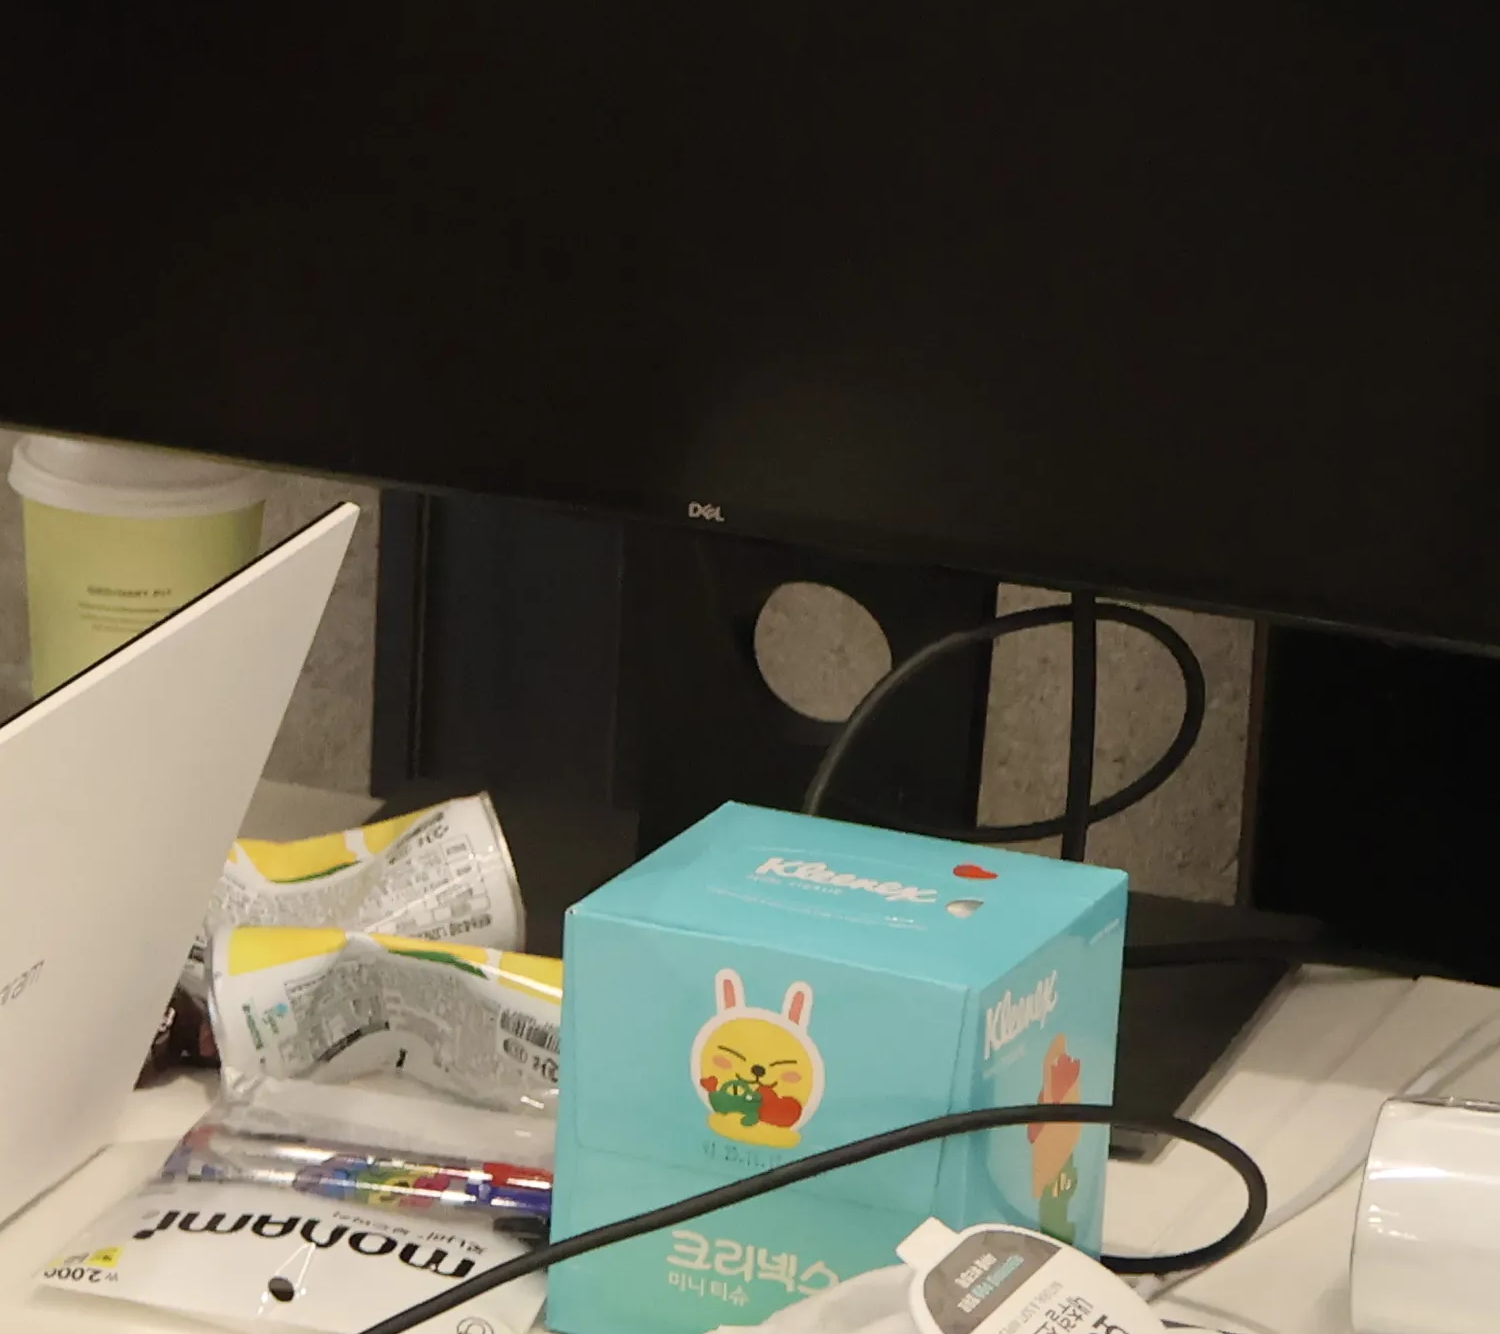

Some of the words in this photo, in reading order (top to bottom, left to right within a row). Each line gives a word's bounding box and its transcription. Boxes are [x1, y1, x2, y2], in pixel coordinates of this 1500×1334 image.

[688, 501, 725, 523] DELL
[755, 856, 938, 904] Kleenex
[984, 969, 1059, 1061] Kleenex
[133, 1208, 478, 1279] monami
[666, 1229, 841, 1295] 크리넥스
[668, 1271, 705, 1297] 미니
[1045, 1295, 1094, 1334] 내추럴
